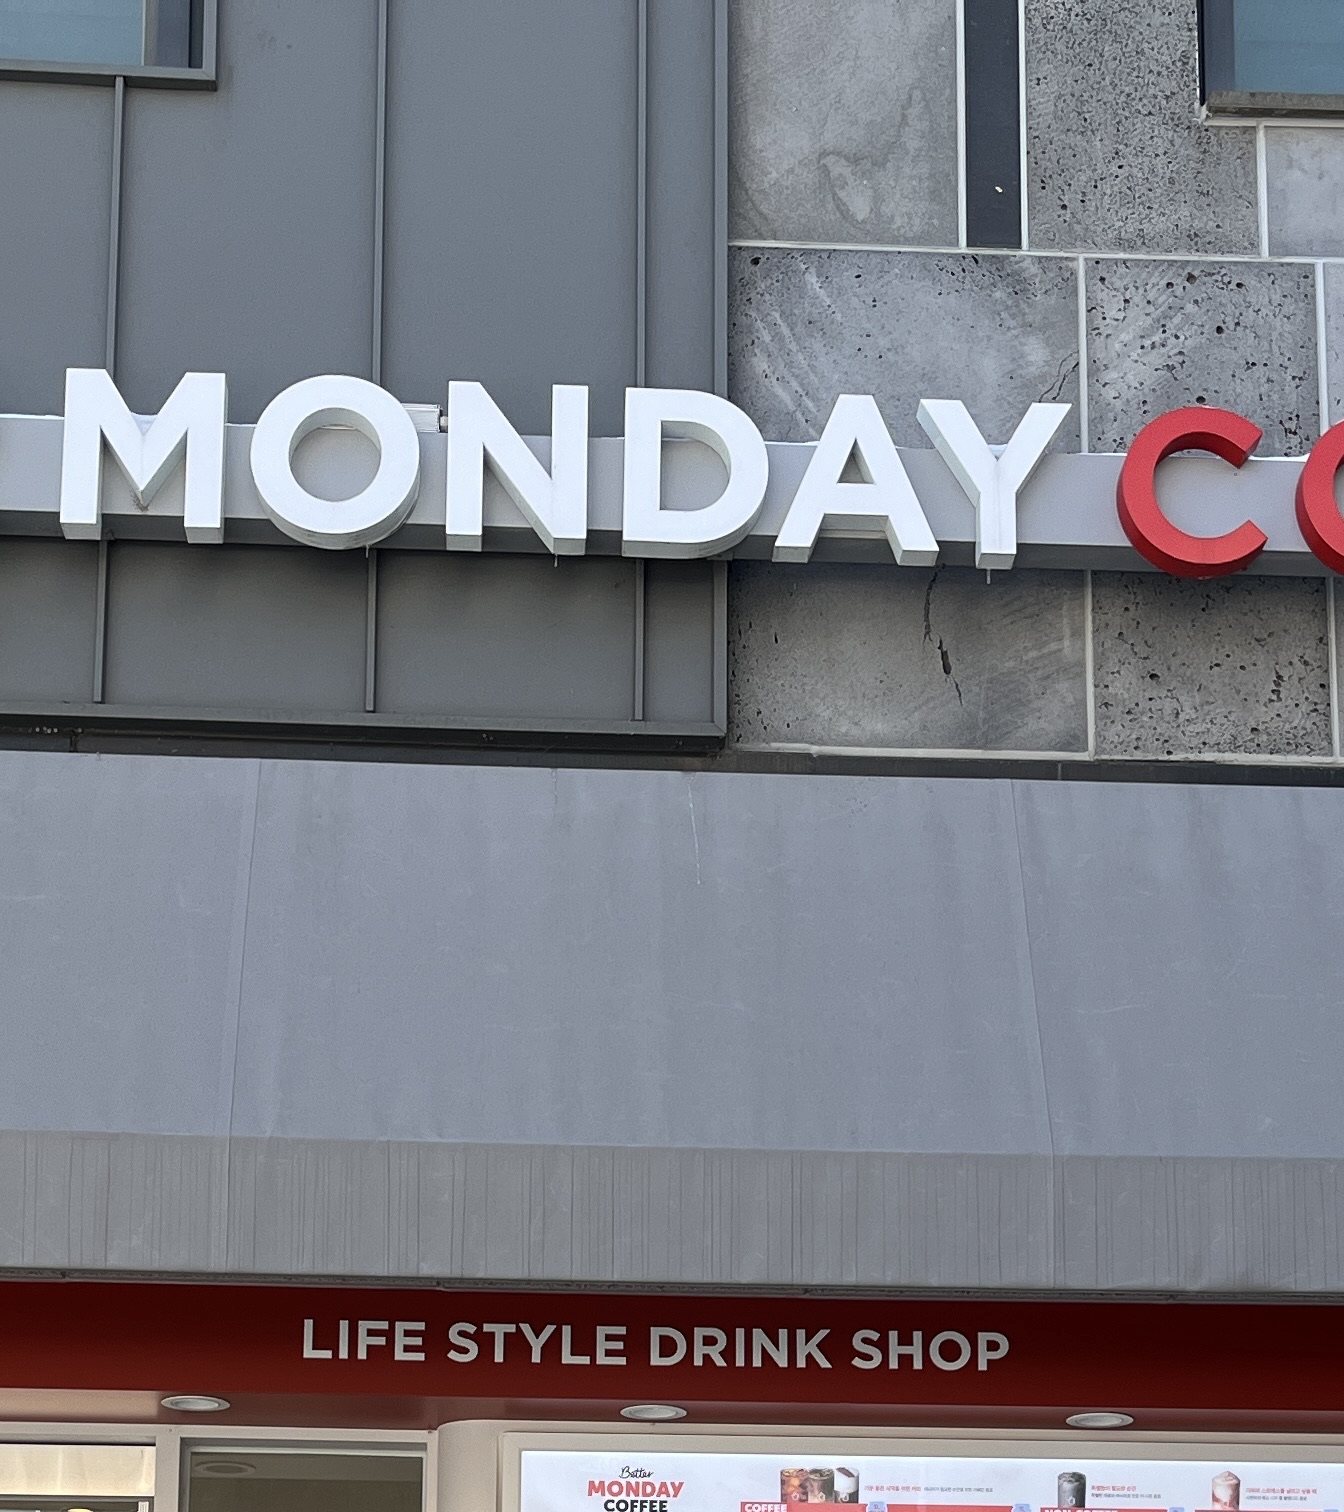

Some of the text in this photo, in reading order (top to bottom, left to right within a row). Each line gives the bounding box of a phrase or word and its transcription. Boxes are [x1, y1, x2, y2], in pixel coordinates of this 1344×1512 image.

[60, 368, 1071, 568] MONDAY
[303, 1319, 1010, 1371] LIFE STYLE DRINK SHOP
[619, 1466, 654, 1479] Better
[587, 1481, 684, 1497] MONDAY
[604, 1499, 668, 1512] COFFEE
[745, 1504, 787, 1512] COFFEE
